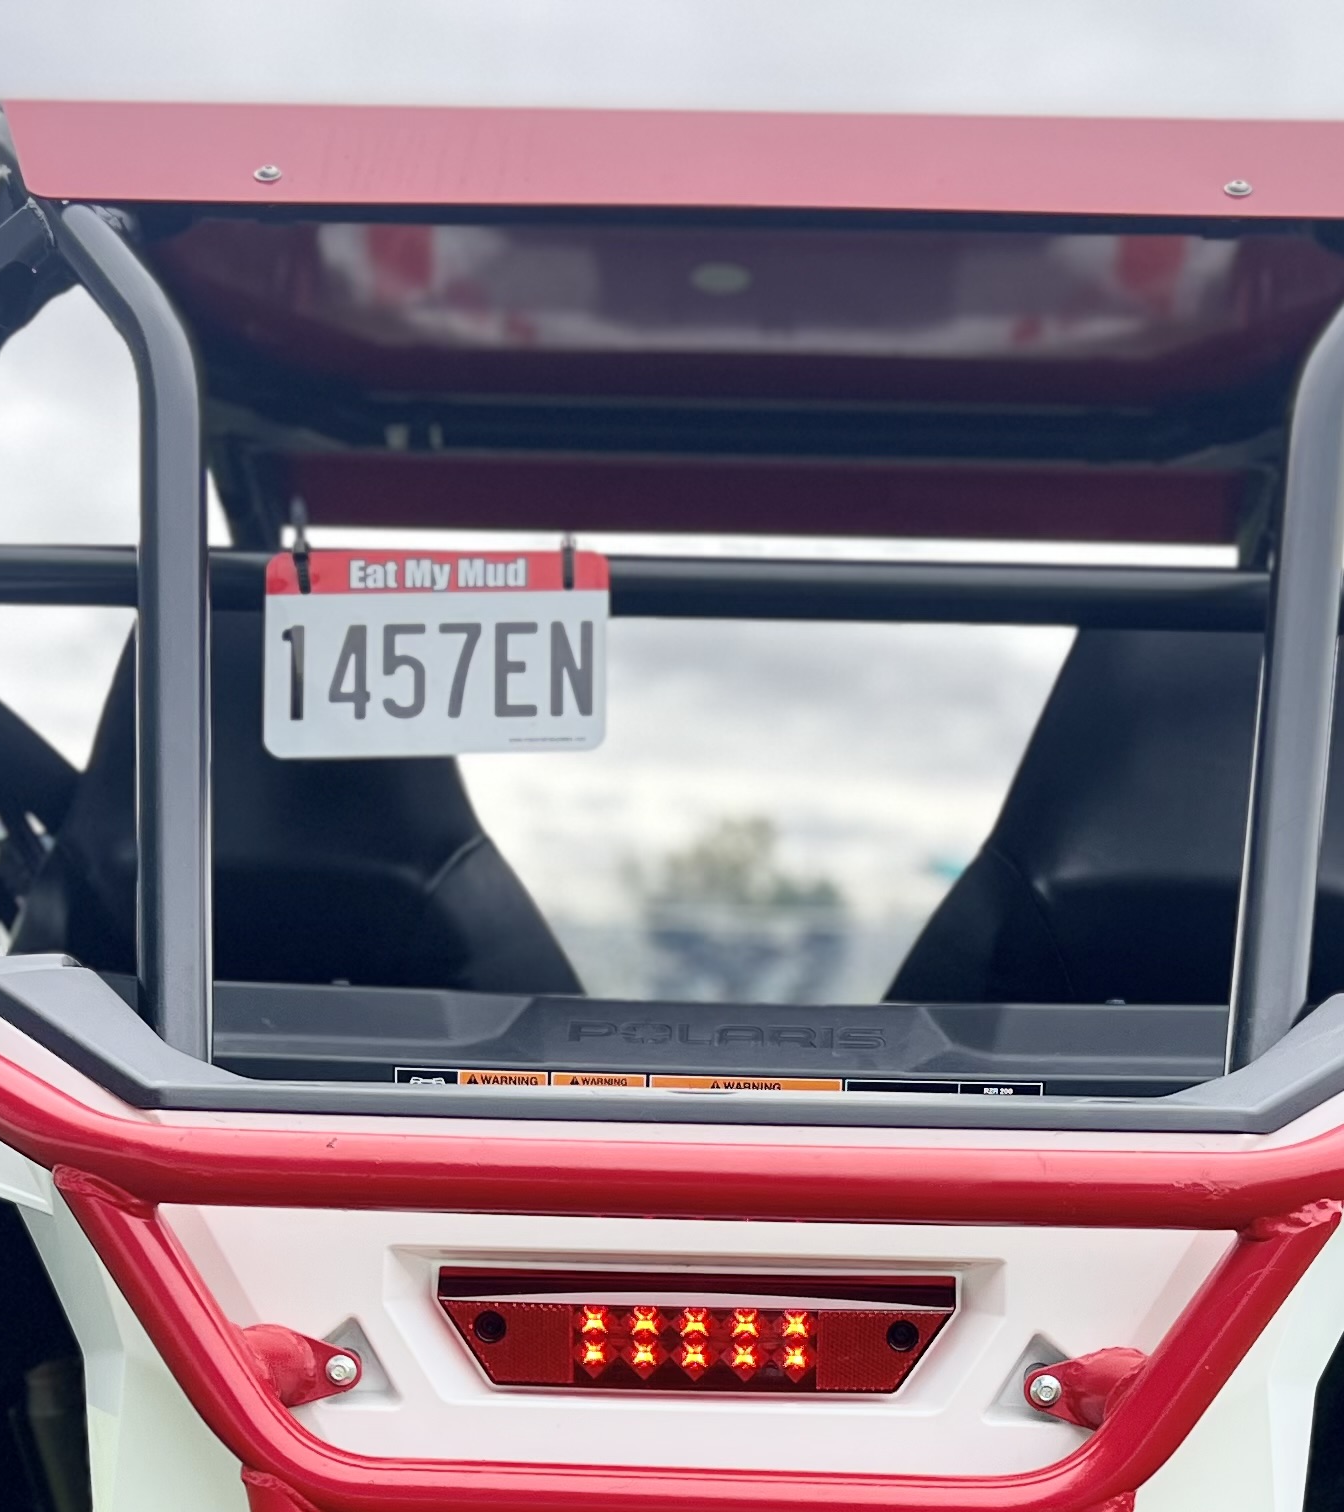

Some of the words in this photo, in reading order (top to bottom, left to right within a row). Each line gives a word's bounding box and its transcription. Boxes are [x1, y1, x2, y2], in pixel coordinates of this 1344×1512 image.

[348, 558, 398, 589] Eat
[404, 558, 451, 591] My
[457, 557, 527, 588] Mud
[281, 620, 594, 721] 1457EN
[567, 1019, 887, 1050] POLARIS
[480, 1074, 539, 1086] WARNING
[581, 1076, 628, 1087] WARNING
